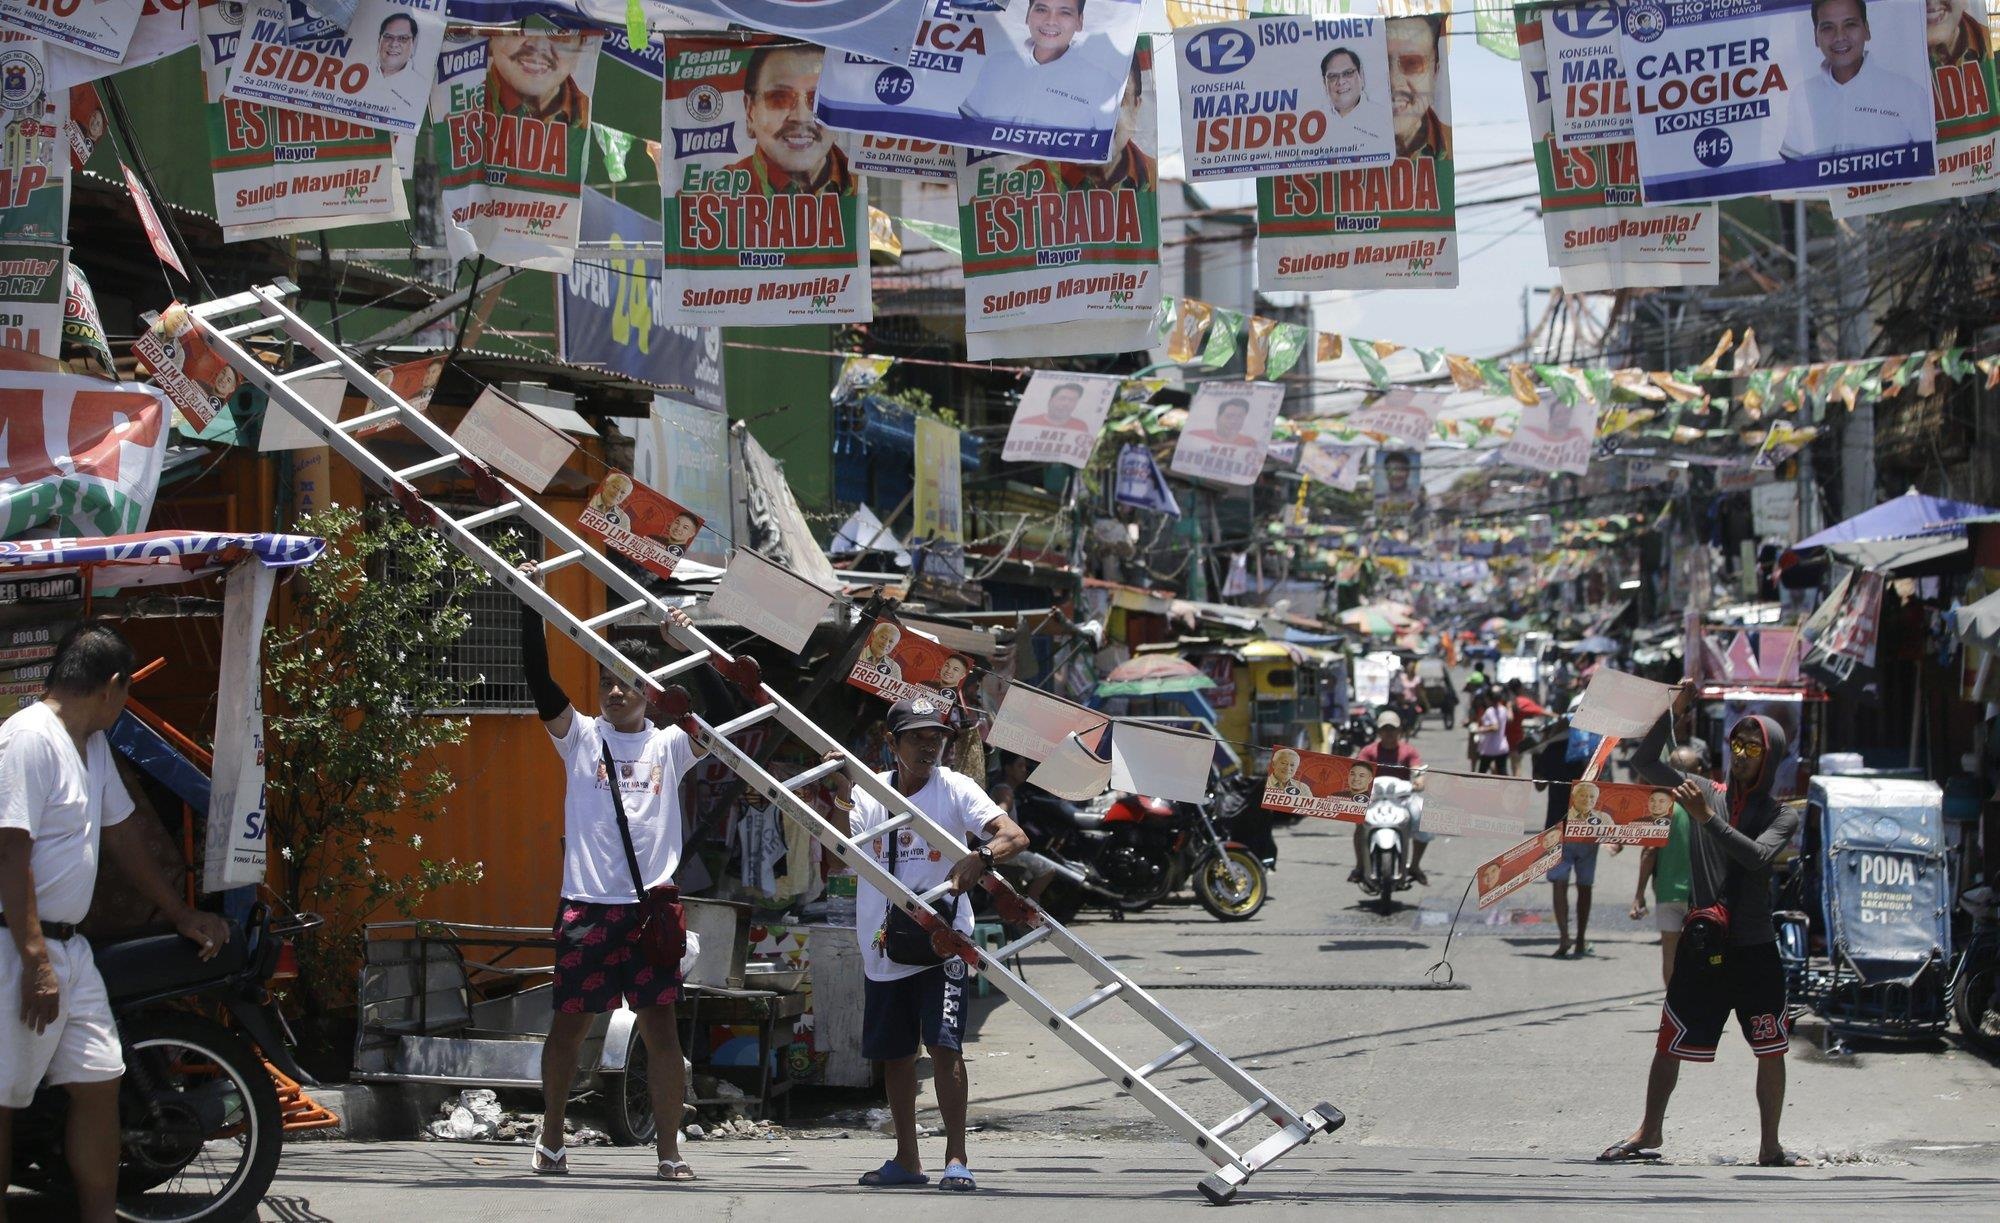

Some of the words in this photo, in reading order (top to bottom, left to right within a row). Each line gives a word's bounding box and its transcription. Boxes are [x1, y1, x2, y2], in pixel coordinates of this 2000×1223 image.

[24, 9, 48, 22] HINDI
[1553, 5, 1614, 33] 12
[1673, 15, 1703, 25] MAYOR
[1709, 9, 1730, 20] VICE
[1731, 4, 1763, 17] MAYOR
[88, 43, 120, 59] ANTIAGO
[1189, 33, 1247, 69] 12
[1258, 21, 1300, 47] ISKO
[1315, 18, 1374, 42] HONEY
[1559, 45, 1614, 60] KONSEHAL
[243, 43, 370, 94] ISIDRO
[442, 50, 485, 76] Vote!
[679, 49, 731, 66] Team
[1636, 37, 1770, 81] CARTER
[672, 60, 742, 81] Legacy
[256, 80, 288, 92] DATING
[288, 87, 309, 98] gawi,
[311, 91, 336, 103] HINDI
[877, 76, 913, 96] #15
[1190, 82, 1246, 95] KONSEHAL
[1637, 63, 1788, 115] LOGICA
[236, 87, 263, 98] LFONSO
[267, 93, 290, 104] OGICA
[316, 104, 358, 119] VANGELISTA
[384, 118, 415, 130] ANTIAGO
[1193, 89, 1298, 119] MARJUN
[1854, 106, 1878, 115] CARTER
[1879, 108, 1900, 118] LOGICA
[1584, 118, 1618, 129] DATING
[1659, 103, 1767, 133] KONSEHAL
[682, 128, 728, 152] Vote!
[991, 126, 1089, 148] DISTRICT
[1089, 133, 1099, 148] 1
[1195, 110, 1328, 153] ISIDRO
[1567, 133, 1596, 142] LFONSO
[1602, 130, 1624, 139] OGICA
[274, 146, 318, 162] Mayor
[1201, 155, 1213, 164] Sa
[1214, 152, 1248, 163] DATING
[1249, 151, 1272, 162] gawi,
[1274, 148, 1300, 159] HINDI
[1696, 137, 1731, 159] #15
[859, 163, 888, 172] LFONSO
[894, 167, 916, 176] OGICA
[879, 153, 912, 163] DATING
[913, 156, 937, 168] gawi,
[1198, 167, 1226, 177] LFONSO
[1230, 165, 1254, 174] OGICA
[1286, 159, 1329, 169] VANGELISTA
[1358, 154, 1391, 164] ANTIAGO
[1818, 150, 1907, 177] DISTRICT
[1911, 147, 1920, 163] 1
[291, 165, 382, 194] Maynila!
[683, 163, 752, 199] Erap
[977, 167, 1046, 199] Erap
[1273, 157, 1440, 217] ESTRADA
[680, 193, 846, 250] ESTRADA
[974, 189, 1142, 256] ESTRADA
[1335, 215, 1381, 231] Mayor
[739, 251, 785, 268] Mayor
[1036, 249, 1082, 266] Mayor
[1277, 252, 1350, 275] Sulong
[1354, 238, 1447, 265] Maynila!
[682, 286, 753, 307] Sulong
[757, 273, 851, 301] Maynila!
[983, 286, 1052, 314] Sulong
[1056, 270, 1148, 299] Maynila!
[137, 337, 164, 371] FRED
[160, 358, 180, 383] LIM
[177, 377, 192, 400] PAUL
[187, 391, 203, 413] DELA
[197, 403, 216, 425] CRUZ
[580, 512, 608, 533] FRED
[608, 525, 629, 543] LIM
[628, 538, 645, 555] PAUL
[643, 546, 659, 563] DELA
[659, 554, 678, 571] CRUZ
[20, 579, 75, 598] PROMO
[12, 629, 49, 645] 800.00
[851, 666, 880, 685] FRED
[881, 676, 902, 692] LIM
[1263, 794, 1292, 807] FRED
[1294, 797, 1315, 809] LIM
[1316, 801, 1332, 811] PAUL
[1333, 803, 1349, 813] DELA
[1350, 805, 1368, 816] CRUZ
[1566, 826, 1595, 837] FRED
[1596, 827, 1617, 837] LIM
[1618, 828, 1634, 837] PAUL
[1635, 828, 1651, 837] DELA
[1652, 829, 1670, 838] CRUZ
[1861, 855, 1915, 887] PODA
[942, 980, 962, 1029] A&F
[1750, 1013, 1779, 1041] 23
